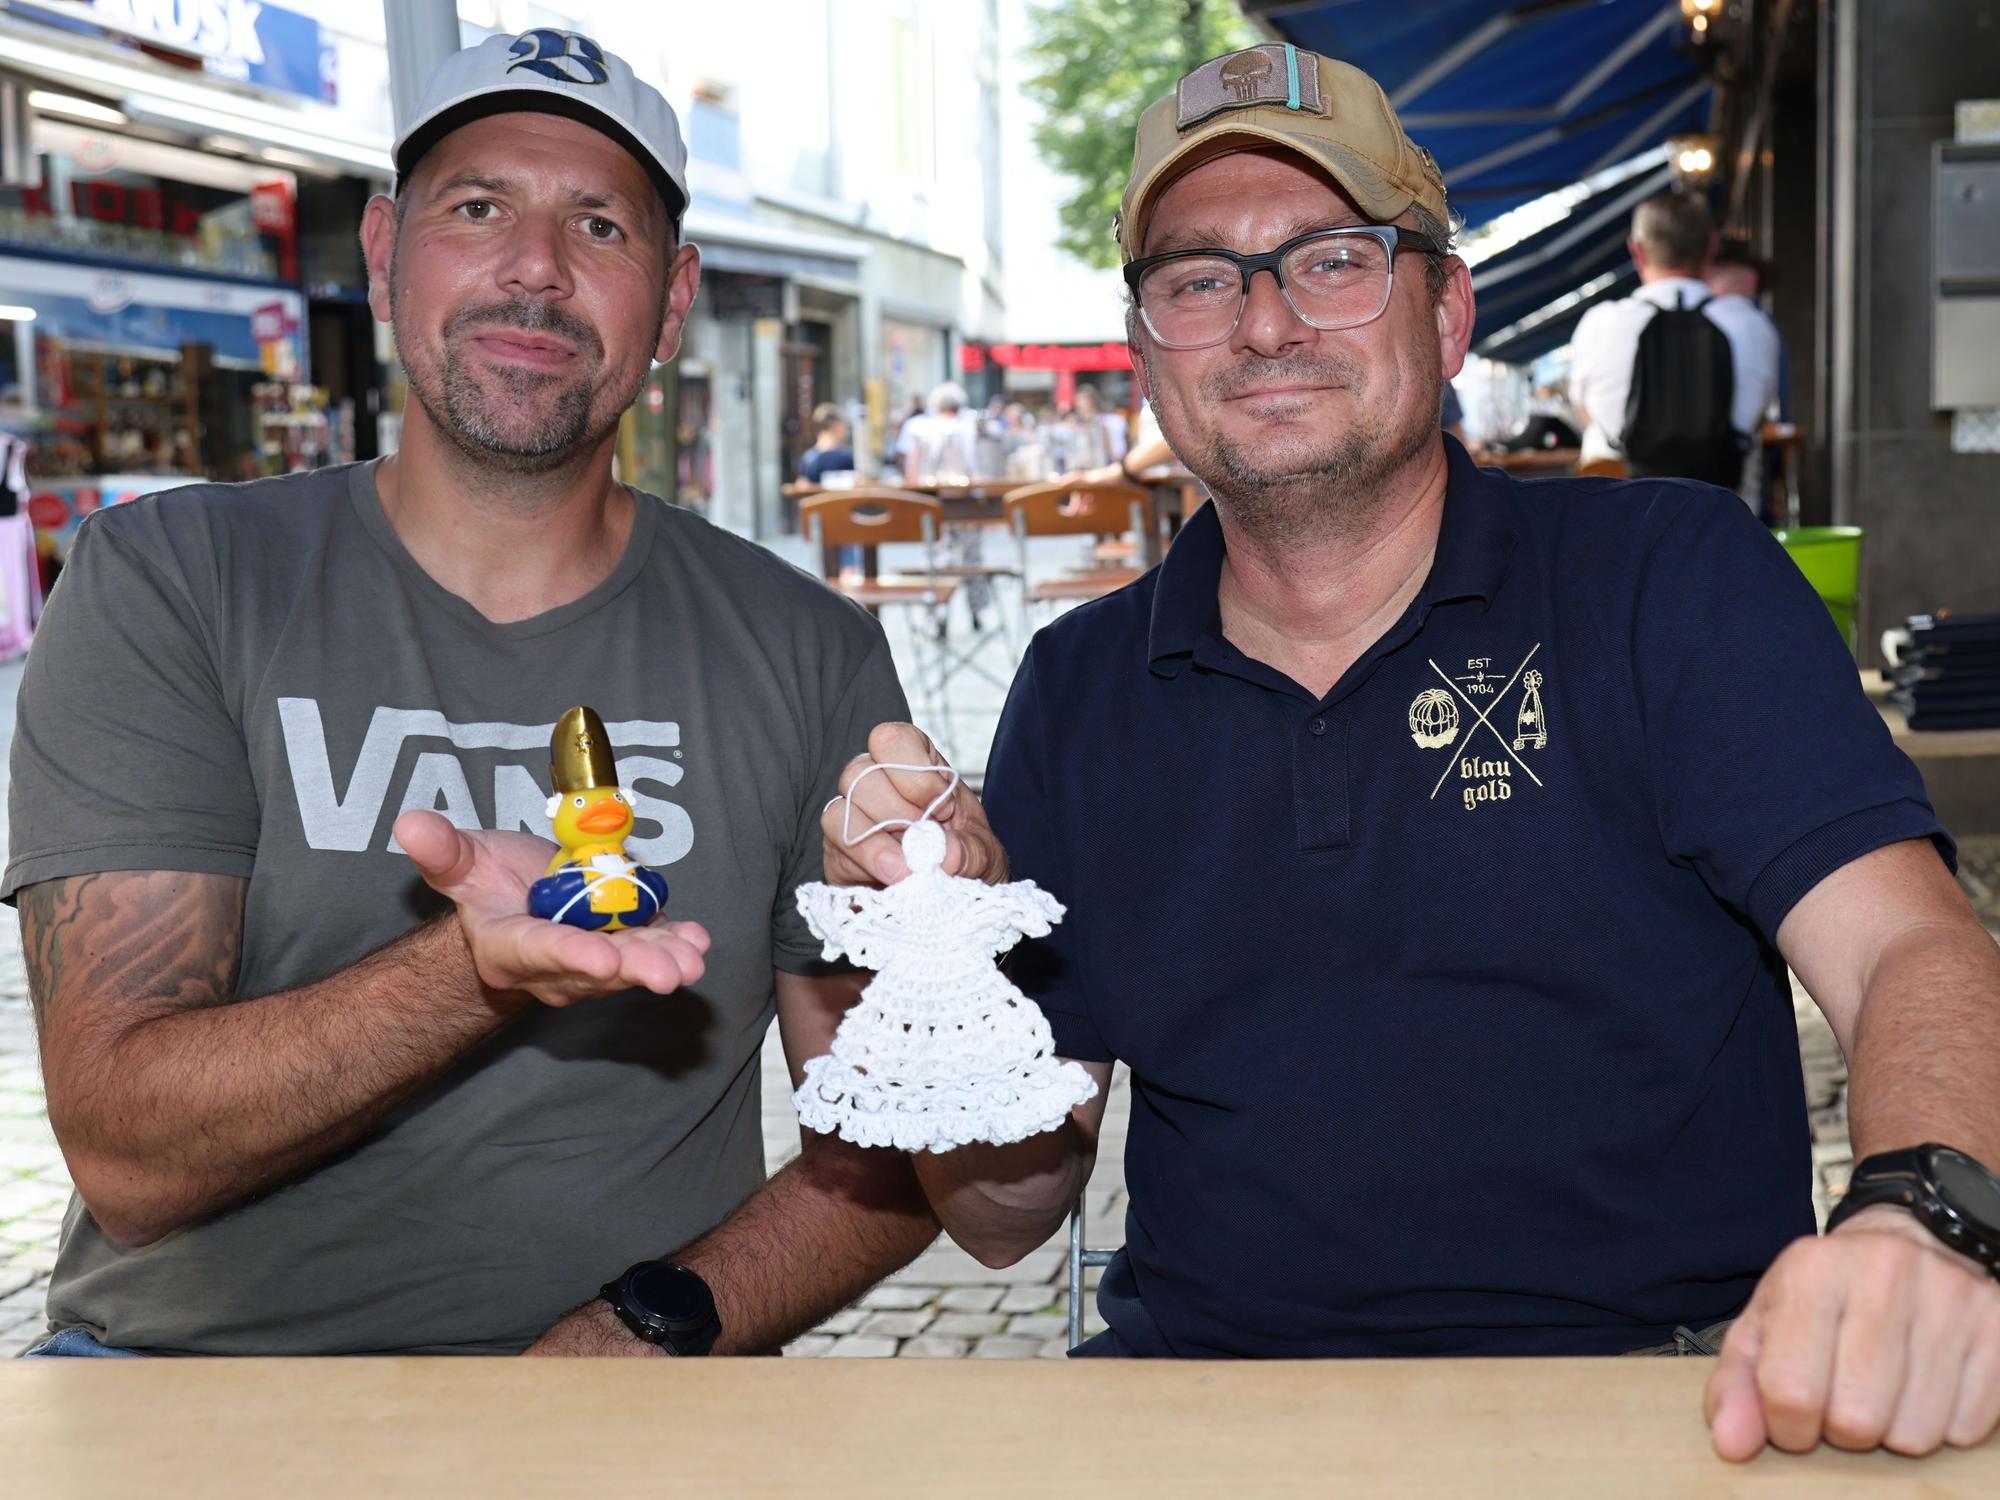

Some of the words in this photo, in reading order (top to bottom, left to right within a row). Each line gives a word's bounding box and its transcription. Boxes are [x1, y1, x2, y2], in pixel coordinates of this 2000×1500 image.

[1467, 658, 1492, 669] EST
[1466, 683, 1494, 694] 1904
[1460, 756, 1512, 779] blau
[1463, 778, 1512, 811] gold
